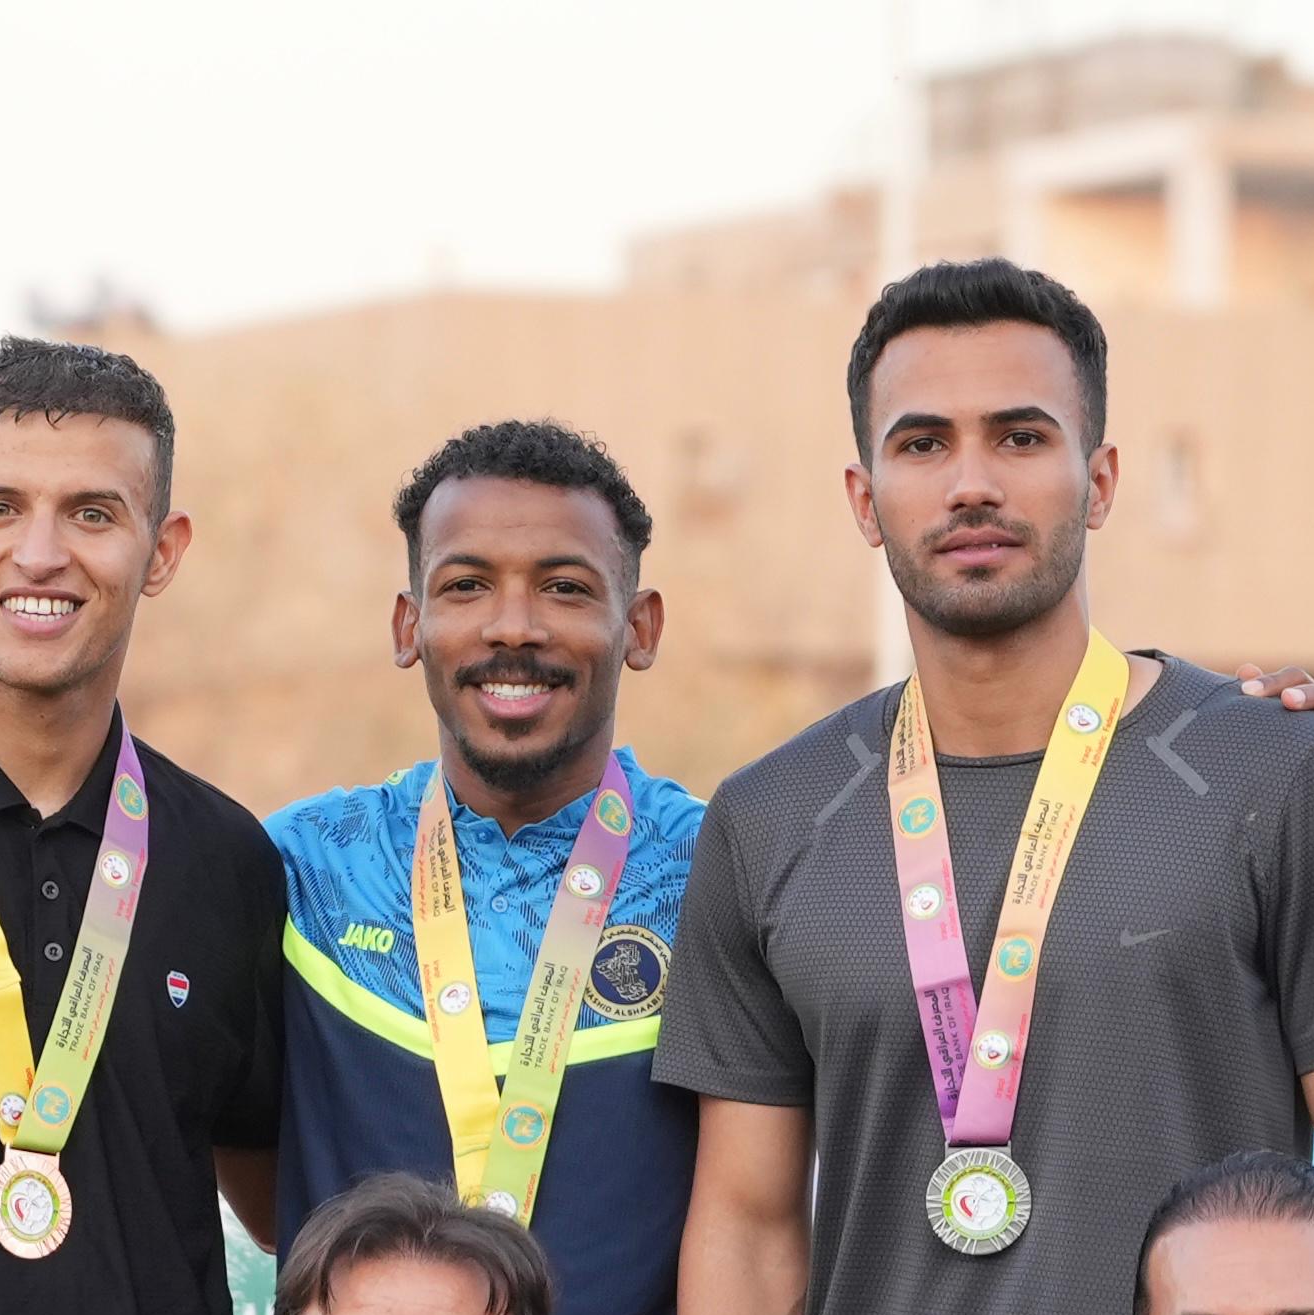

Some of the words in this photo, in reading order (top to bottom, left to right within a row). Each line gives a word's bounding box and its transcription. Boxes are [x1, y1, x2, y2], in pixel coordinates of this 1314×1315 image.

[1025, 874, 1041, 906] TRADE
[1036, 844, 1049, 870] BANK
[1051, 801, 1063, 825] IRAQ
[338, 922, 394, 953] JAKO
[79, 946, 93, 982] المصرف
[540, 961, 556, 997] المصرف
[555, 964, 569, 988] IRAQ
[68, 981, 84, 1018] العراقي
[69, 1024, 84, 1053] TRADE
[82, 993, 93, 1020] BANK
[88, 977, 97, 991] OF
[93, 952, 104, 975] IRAQ
[551, 990, 560, 1004] OF
[924, 989, 943, 1026] المصرف
[941, 986, 952, 1011] IRAQ
[530, 996, 545, 1035] العراقي
[543, 1006, 557, 1033] BANK
[947, 1016, 957, 1029] OF
[55, 1016, 73, 1049] للتجارة
[933, 1030, 953, 1066] العراقي
[951, 1034, 964, 1060] BANK
[519, 1034, 535, 1067] للتجارة
[534, 1037, 549, 1069] TRADE
